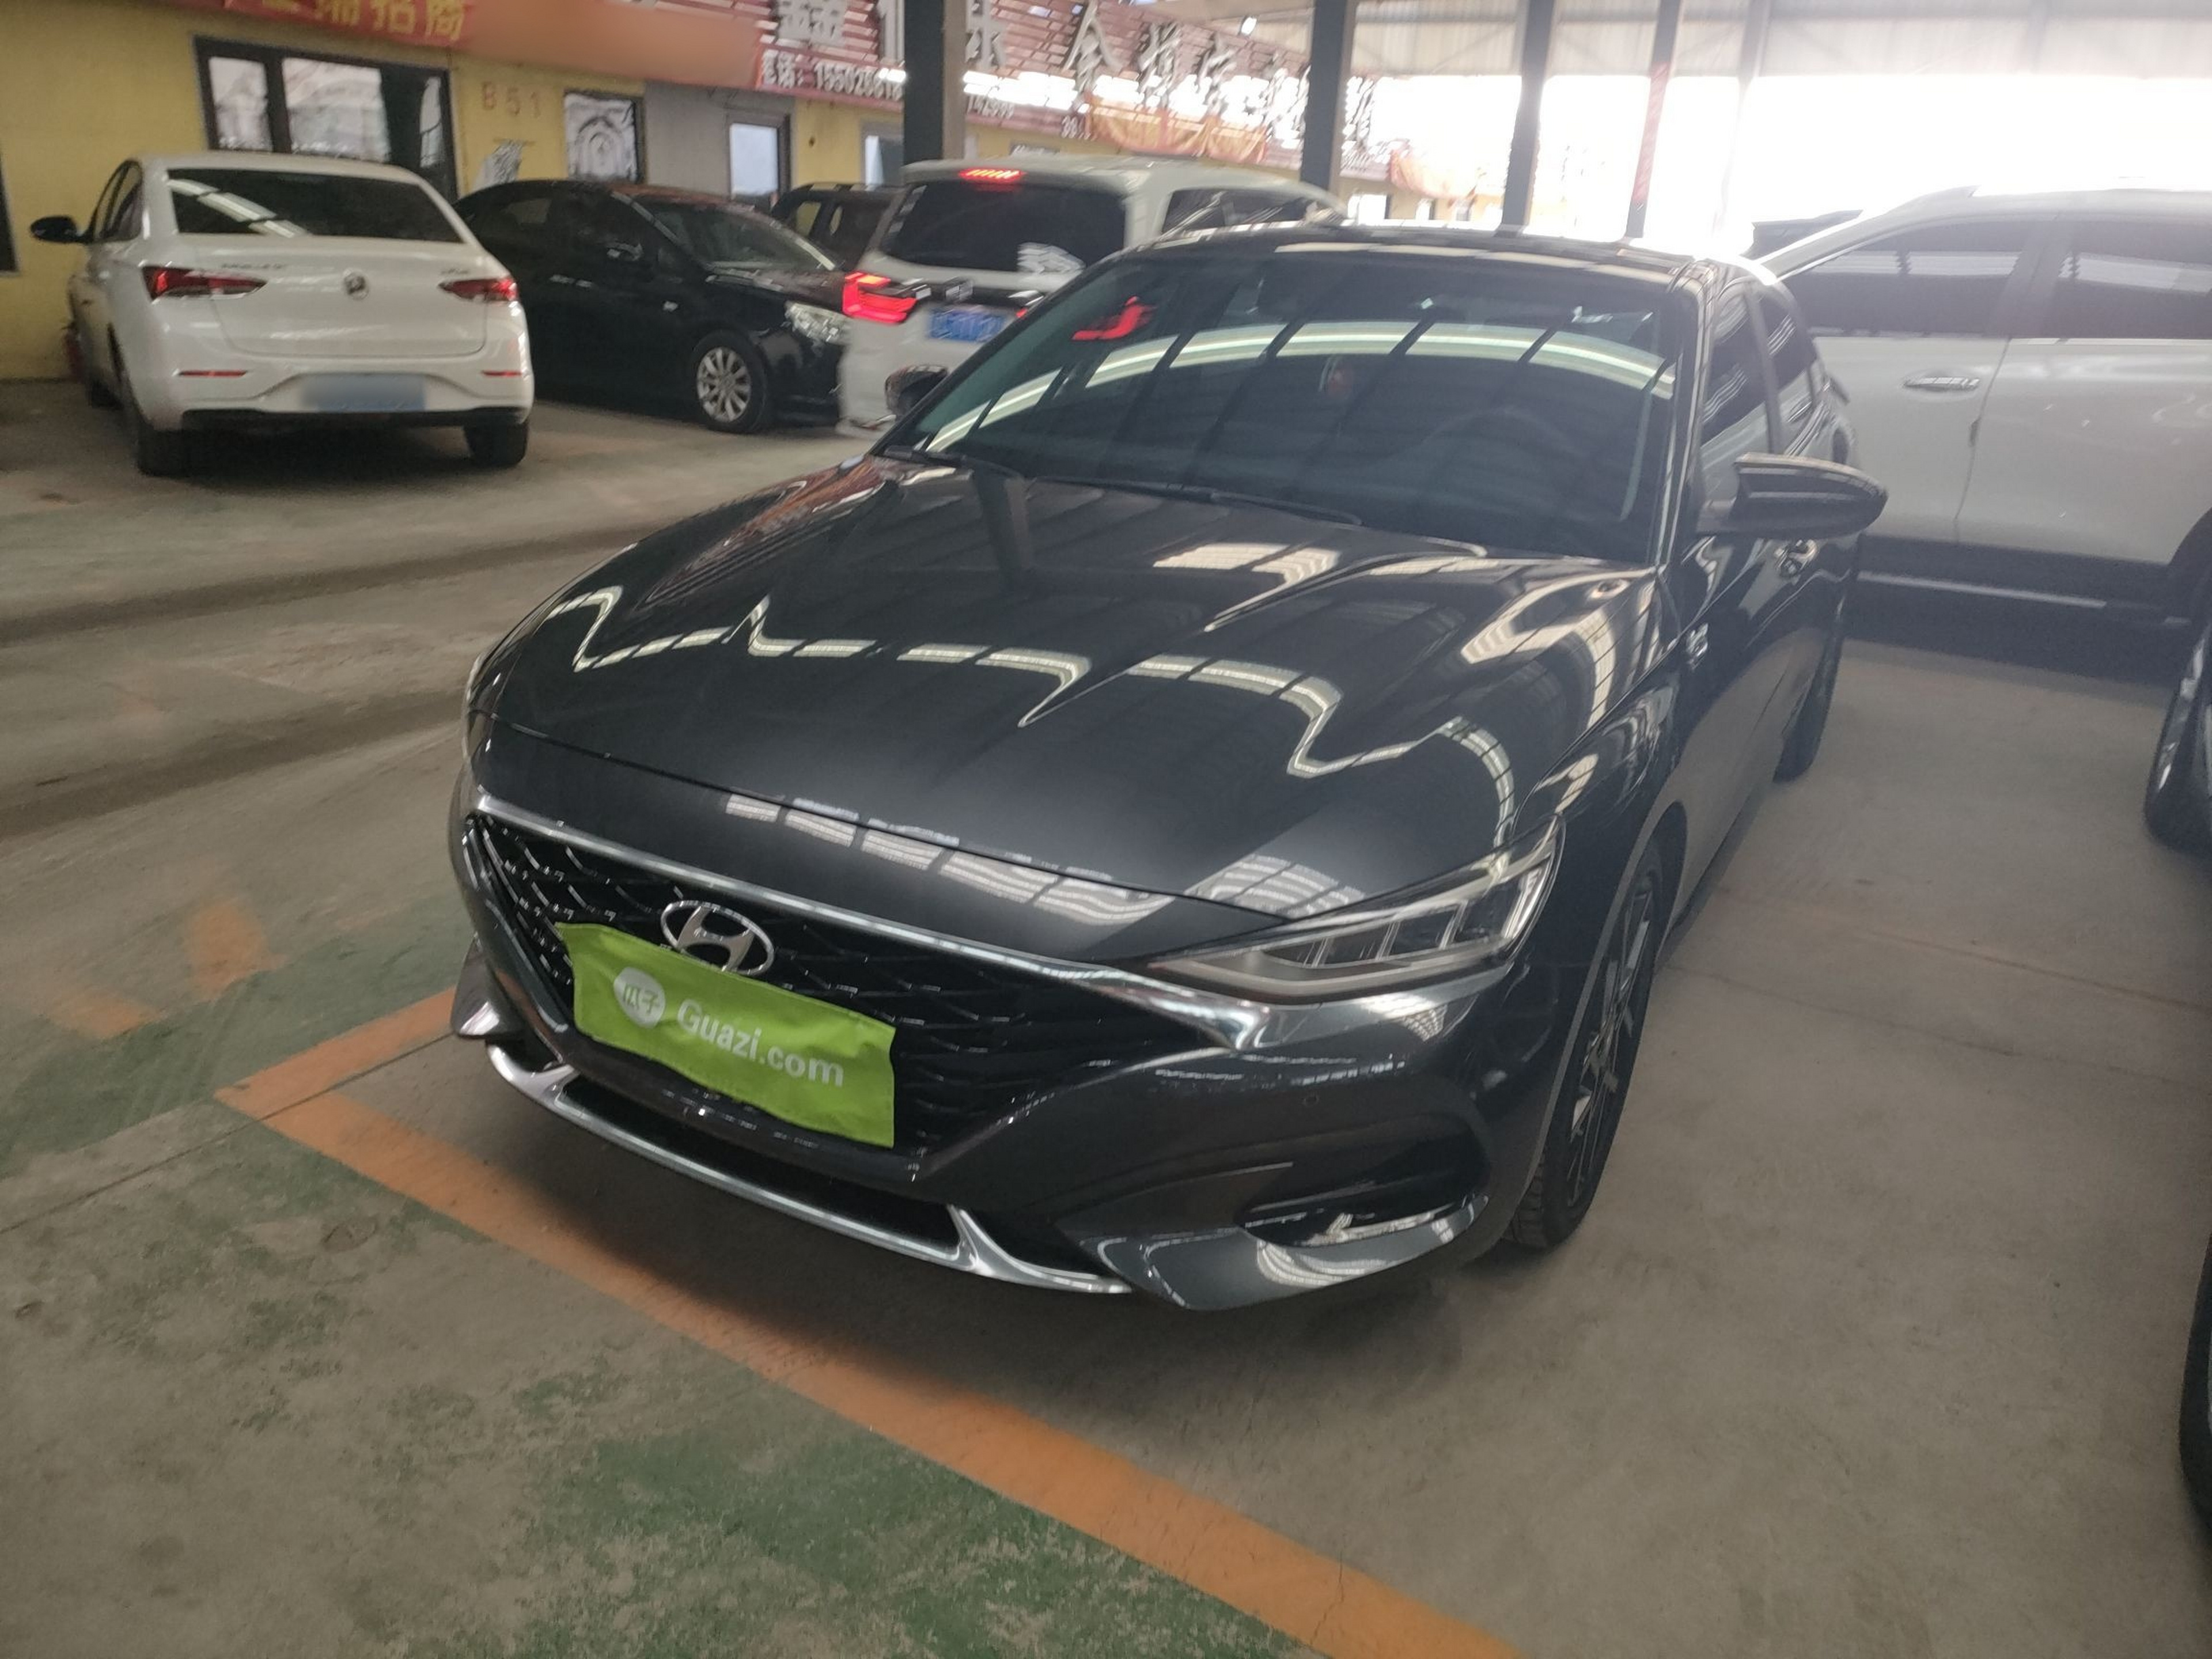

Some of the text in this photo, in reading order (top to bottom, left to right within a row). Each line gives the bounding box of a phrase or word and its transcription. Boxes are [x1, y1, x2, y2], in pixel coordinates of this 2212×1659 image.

[262, 0, 464, 43] 铺招商
[622, 983, 661, 1015] 瓜子
[677, 999, 844, 1088] Guazi.com
